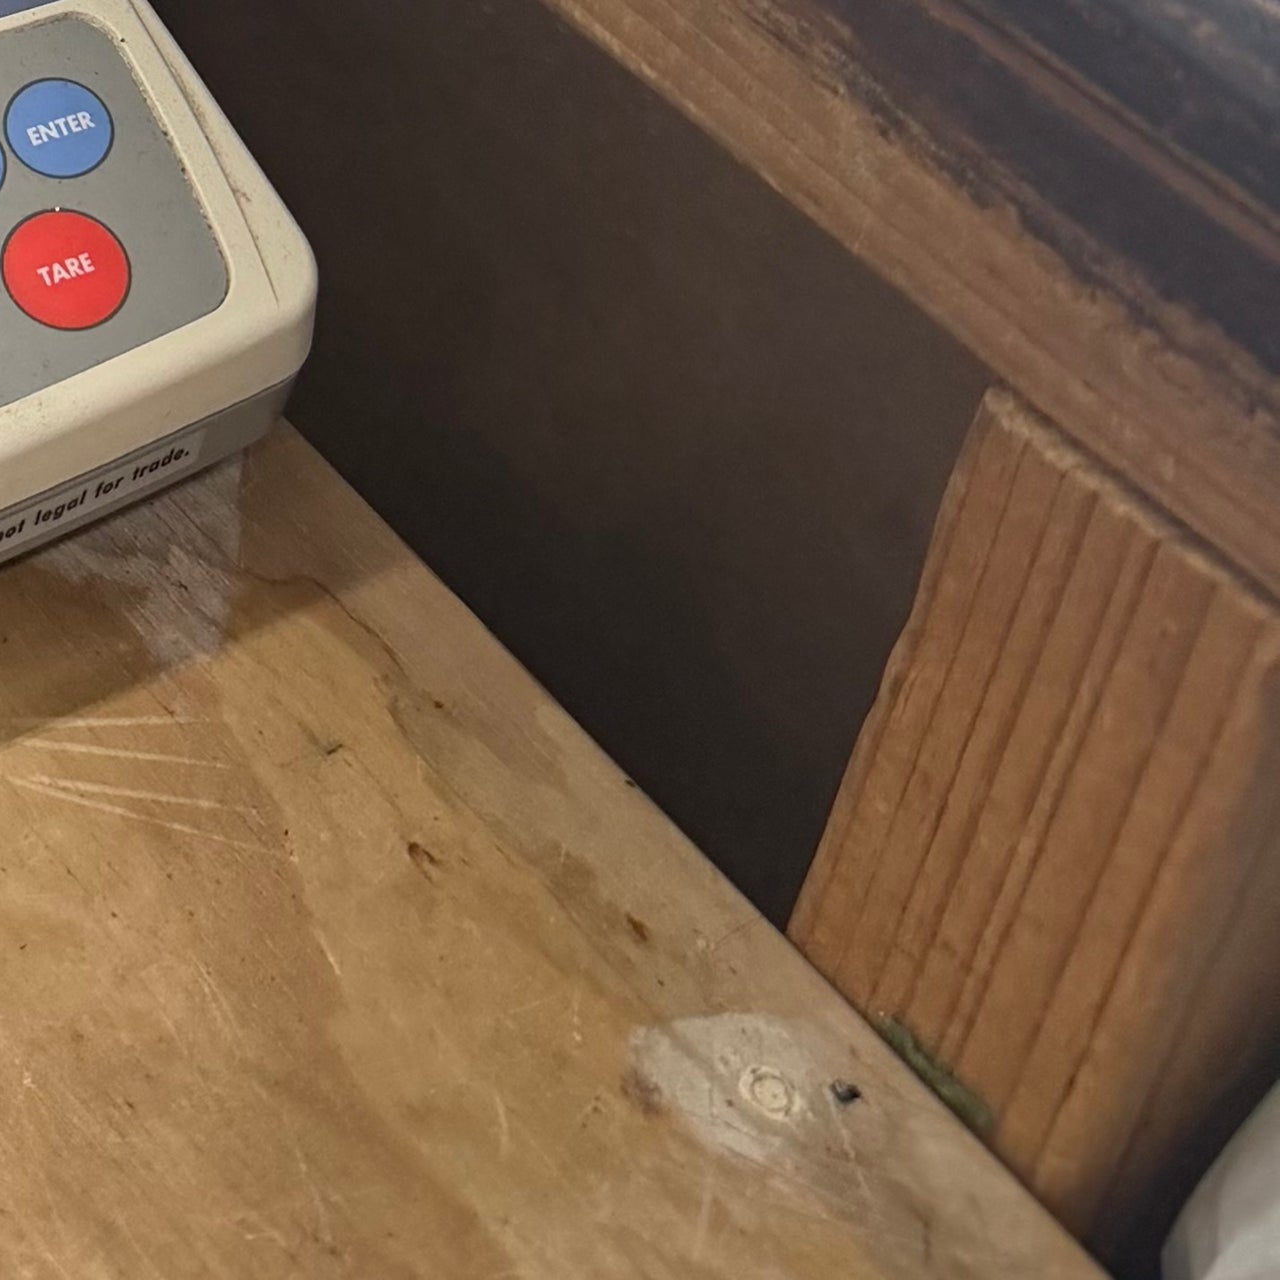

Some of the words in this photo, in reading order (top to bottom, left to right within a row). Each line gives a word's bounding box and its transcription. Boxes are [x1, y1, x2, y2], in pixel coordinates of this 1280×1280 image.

[26, 110, 96, 147] ENTER
[36, 252, 96, 287] TARE
[34, 490, 87, 526] legal
[94, 475, 125, 499] for
[132, 448, 190, 481] trade.
